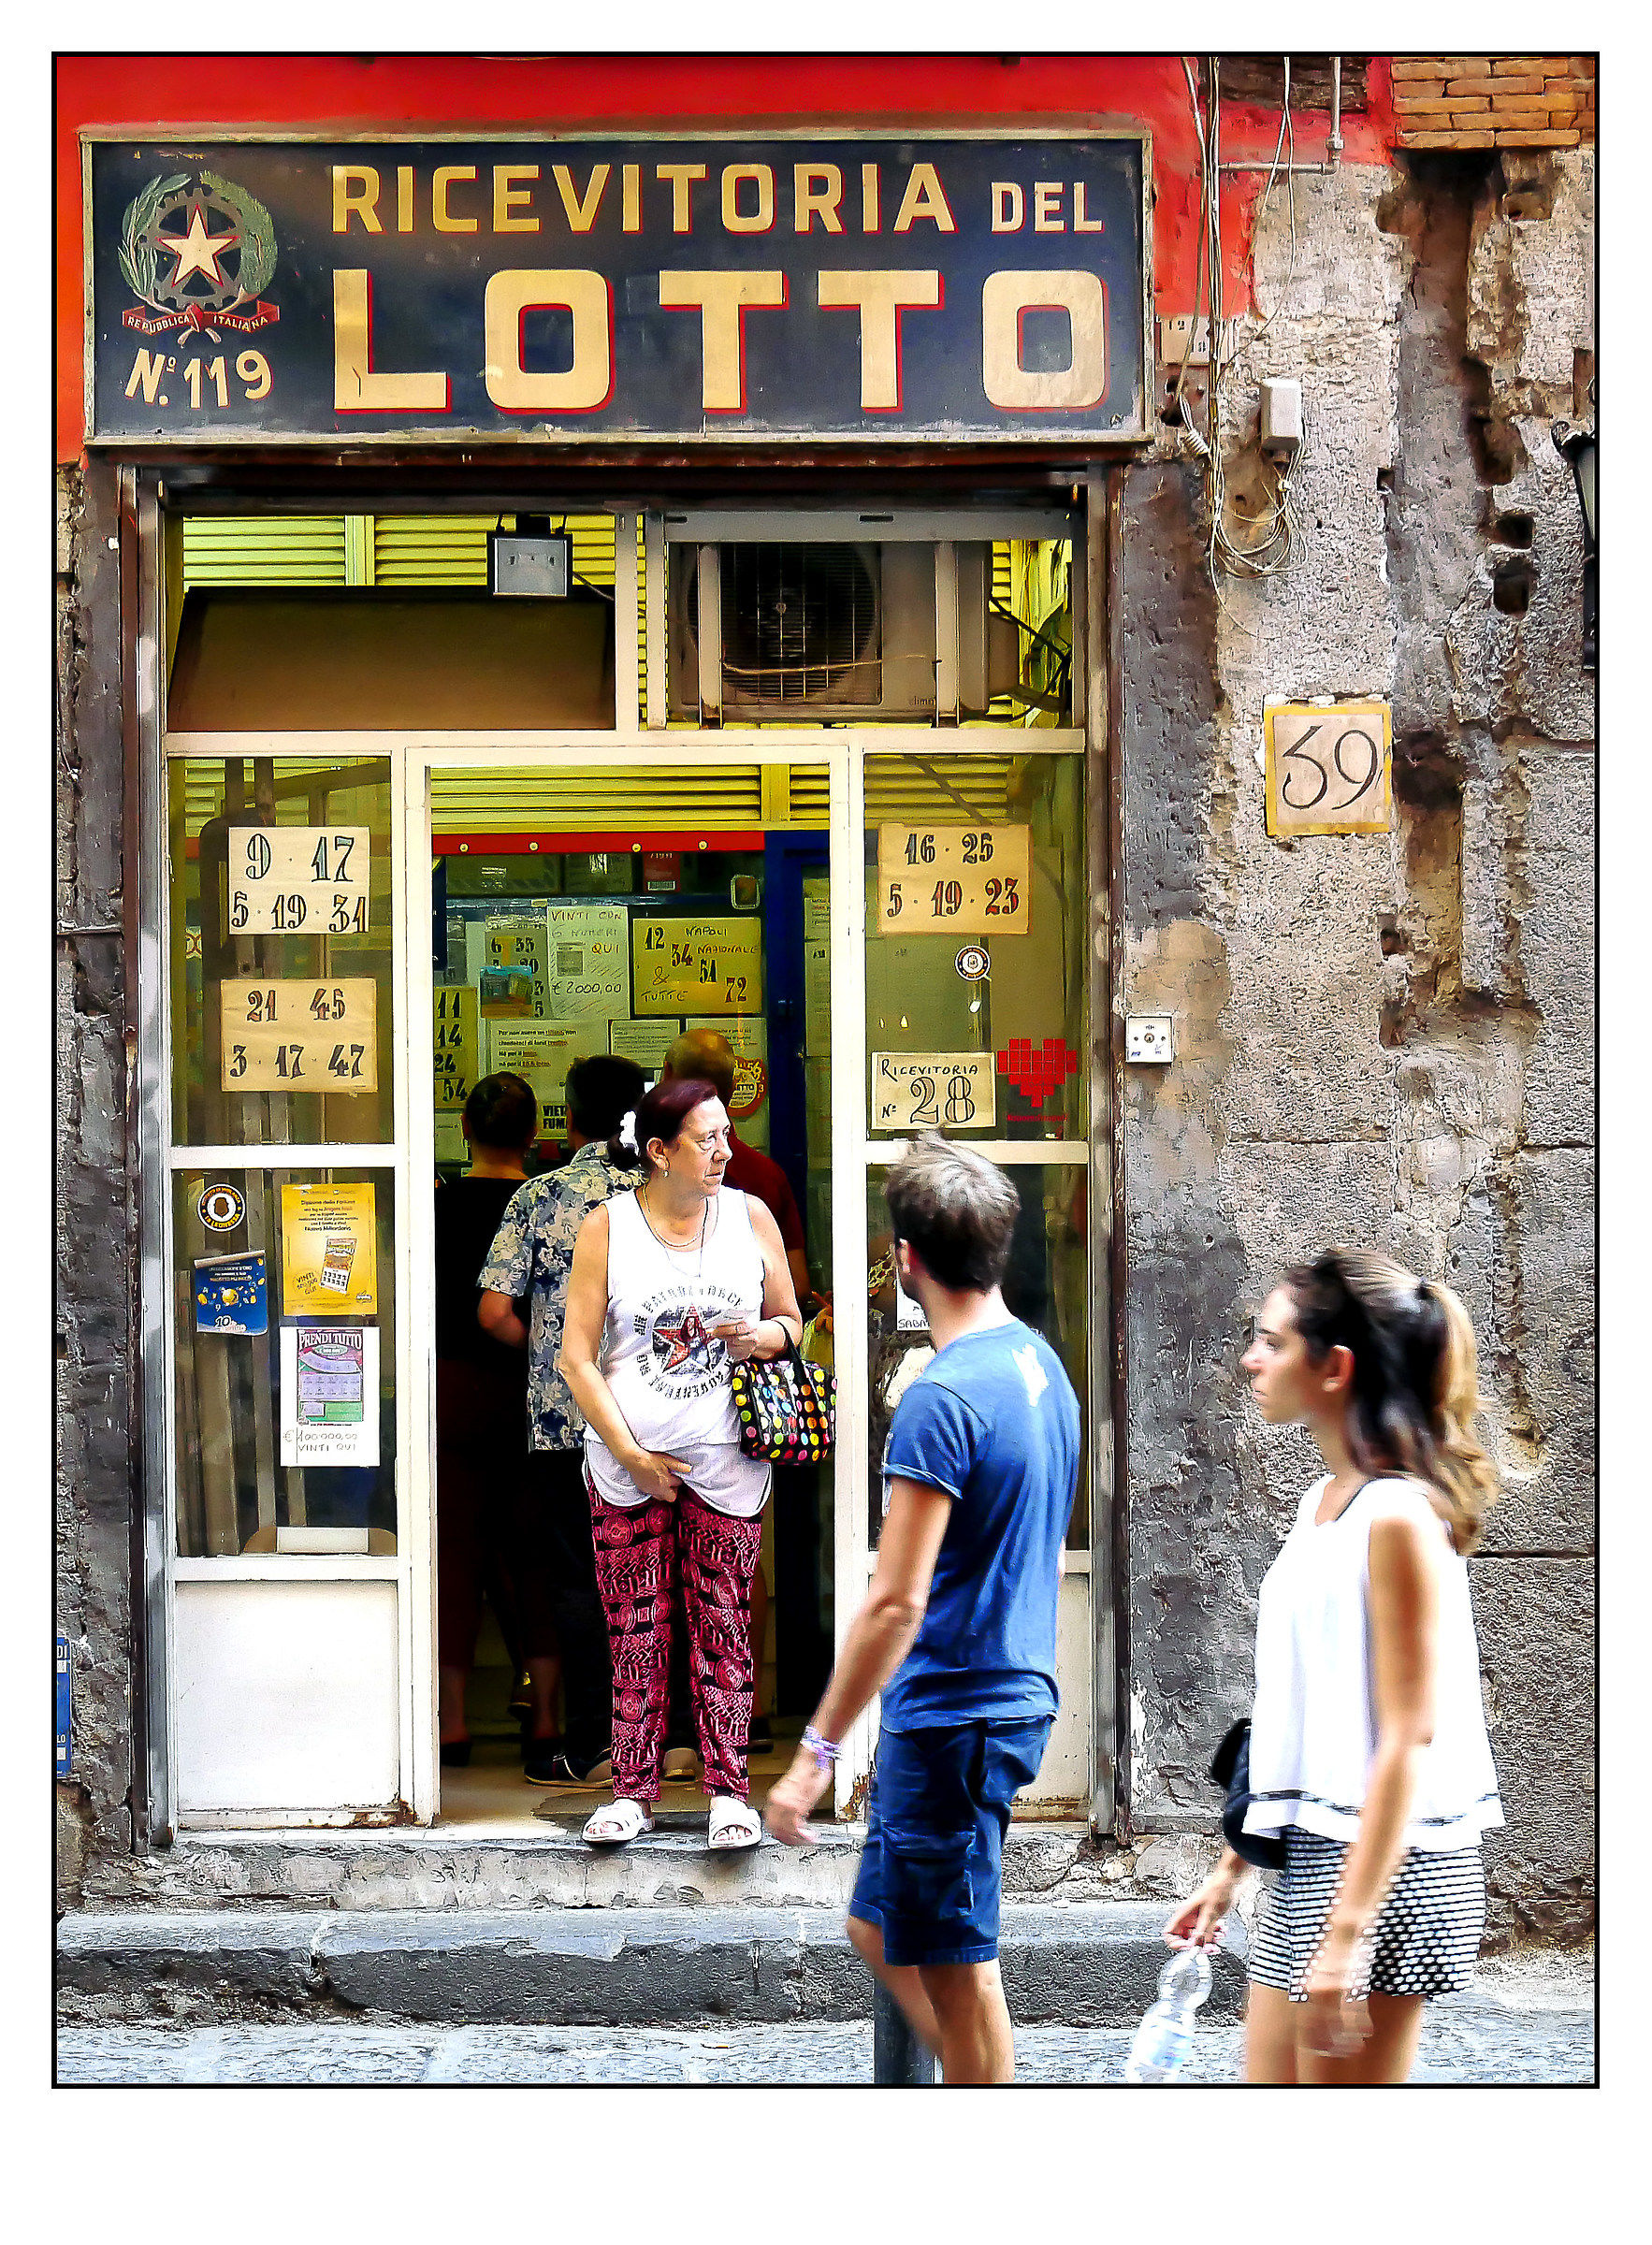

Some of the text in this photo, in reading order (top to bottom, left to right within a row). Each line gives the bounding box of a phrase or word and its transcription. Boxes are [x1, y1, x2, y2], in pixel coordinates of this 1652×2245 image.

[332, 165, 1104, 234] RICEVITORIA DEL
[127, 314, 268, 334] REPUBBLICA ITALIANA
[333, 269, 1109, 413] LOTTO
[183, 349, 274, 410] 119
[245, 833, 355, 882] 9 17
[905, 832, 994, 865] 16 25
[231, 891, 370, 934] 5 19 31
[887, 877, 1020, 918] 5 19 23
[551, 909, 588, 921] VINTI
[591, 942, 619, 954] QUI
[645, 925, 728, 950] 12 NAPOLI
[671, 943, 693, 967] 34
[246, 988, 346, 1022] 21 45
[725, 977, 748, 1004] 72
[437, 1023, 463, 1048] 14
[229, 1044, 365, 1079] 3 17 47
[881, 1058, 978, 1082] RICEVITORIA
[910, 1075, 976, 1123] 28
[299, 1331, 332, 1350] PRENDI
[332, 1331, 363, 1351] TUTTO
[297, 1443, 329, 1452] VINTI
